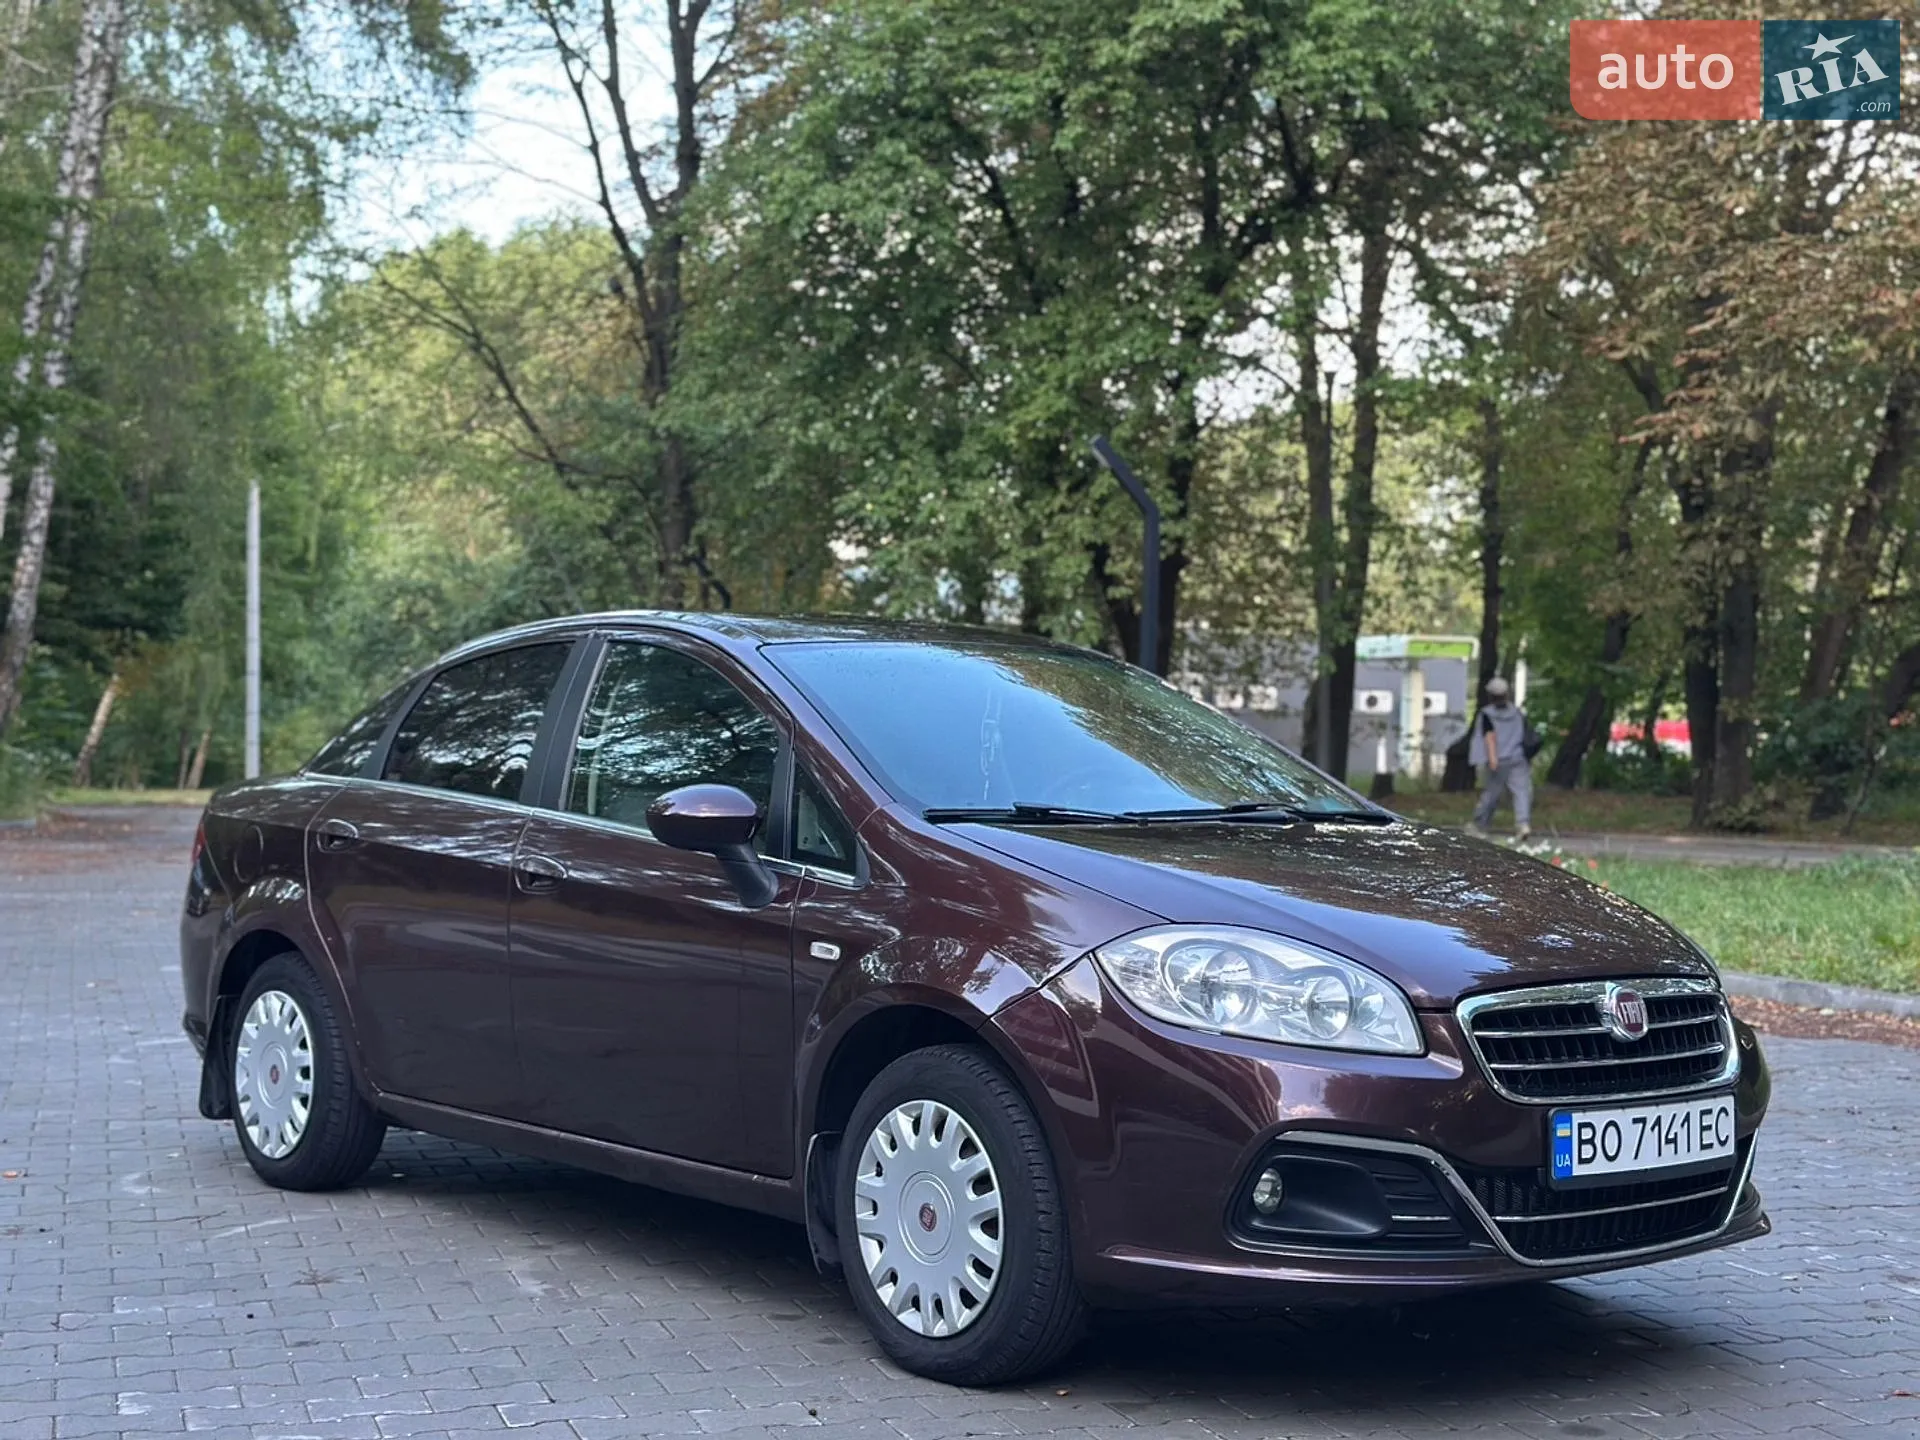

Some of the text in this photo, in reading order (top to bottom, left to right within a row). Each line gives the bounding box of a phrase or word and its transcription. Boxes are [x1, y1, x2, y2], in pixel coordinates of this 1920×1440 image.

[1618, 1001, 1643, 1024] FIAT
[1577, 1106, 1730, 1165] BO 7141 EC
[1556, 1154, 1571, 1168] UA
